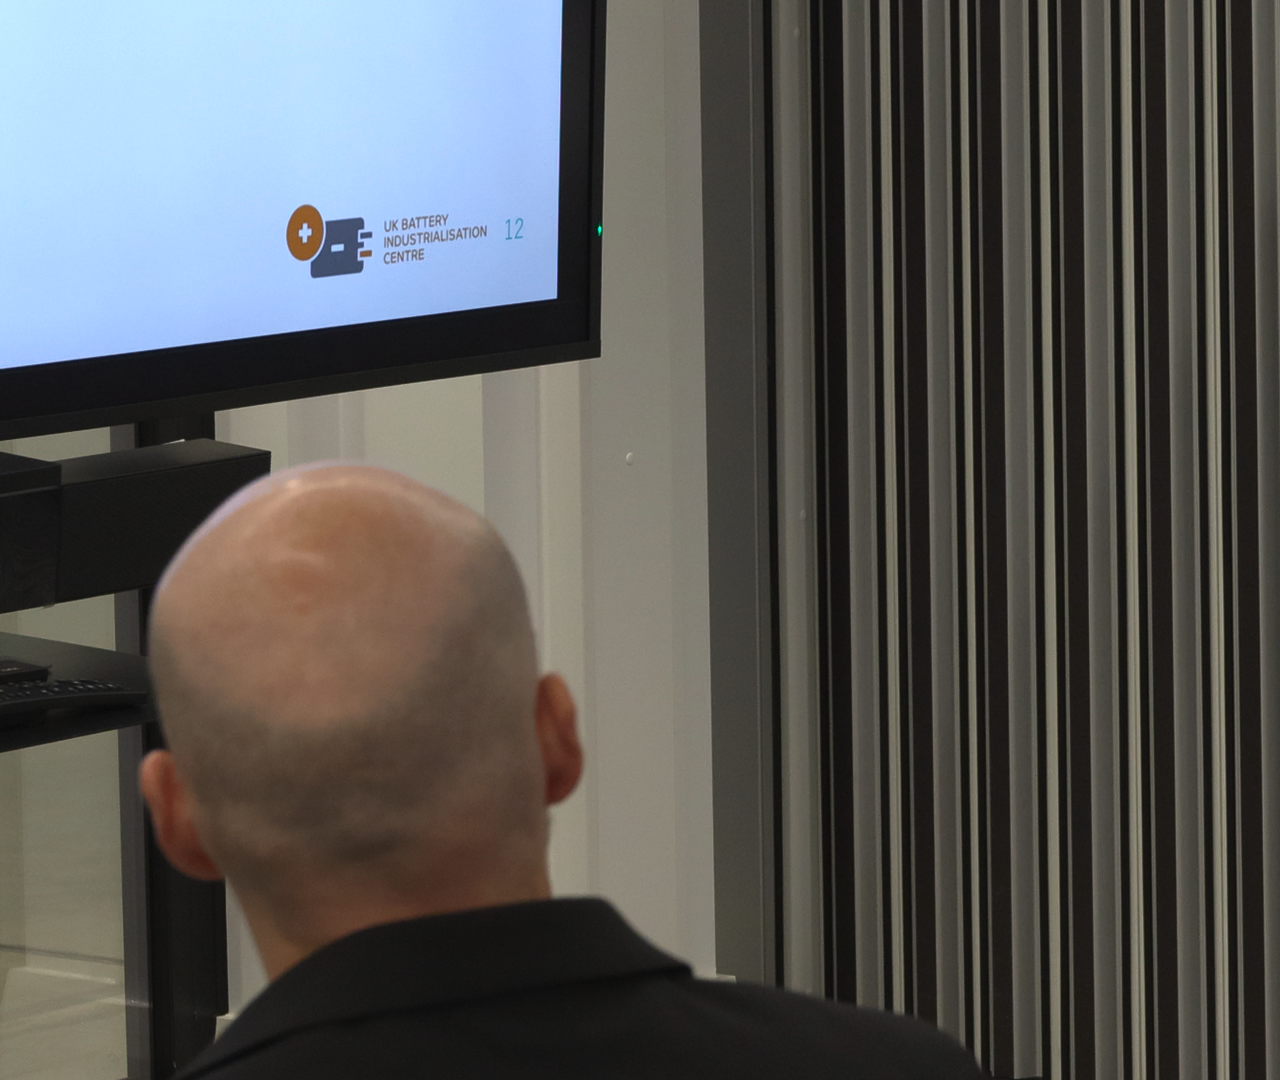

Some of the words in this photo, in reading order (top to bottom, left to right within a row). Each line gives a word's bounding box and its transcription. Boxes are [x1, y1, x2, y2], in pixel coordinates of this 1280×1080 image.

[384, 219, 399, 233] UK
[401, 213, 449, 231] BATTERY
[505, 217, 524, 240] 12
[383, 225, 488, 248] INDUSTRIALISATION
[383, 248, 425, 265] CENTRE
